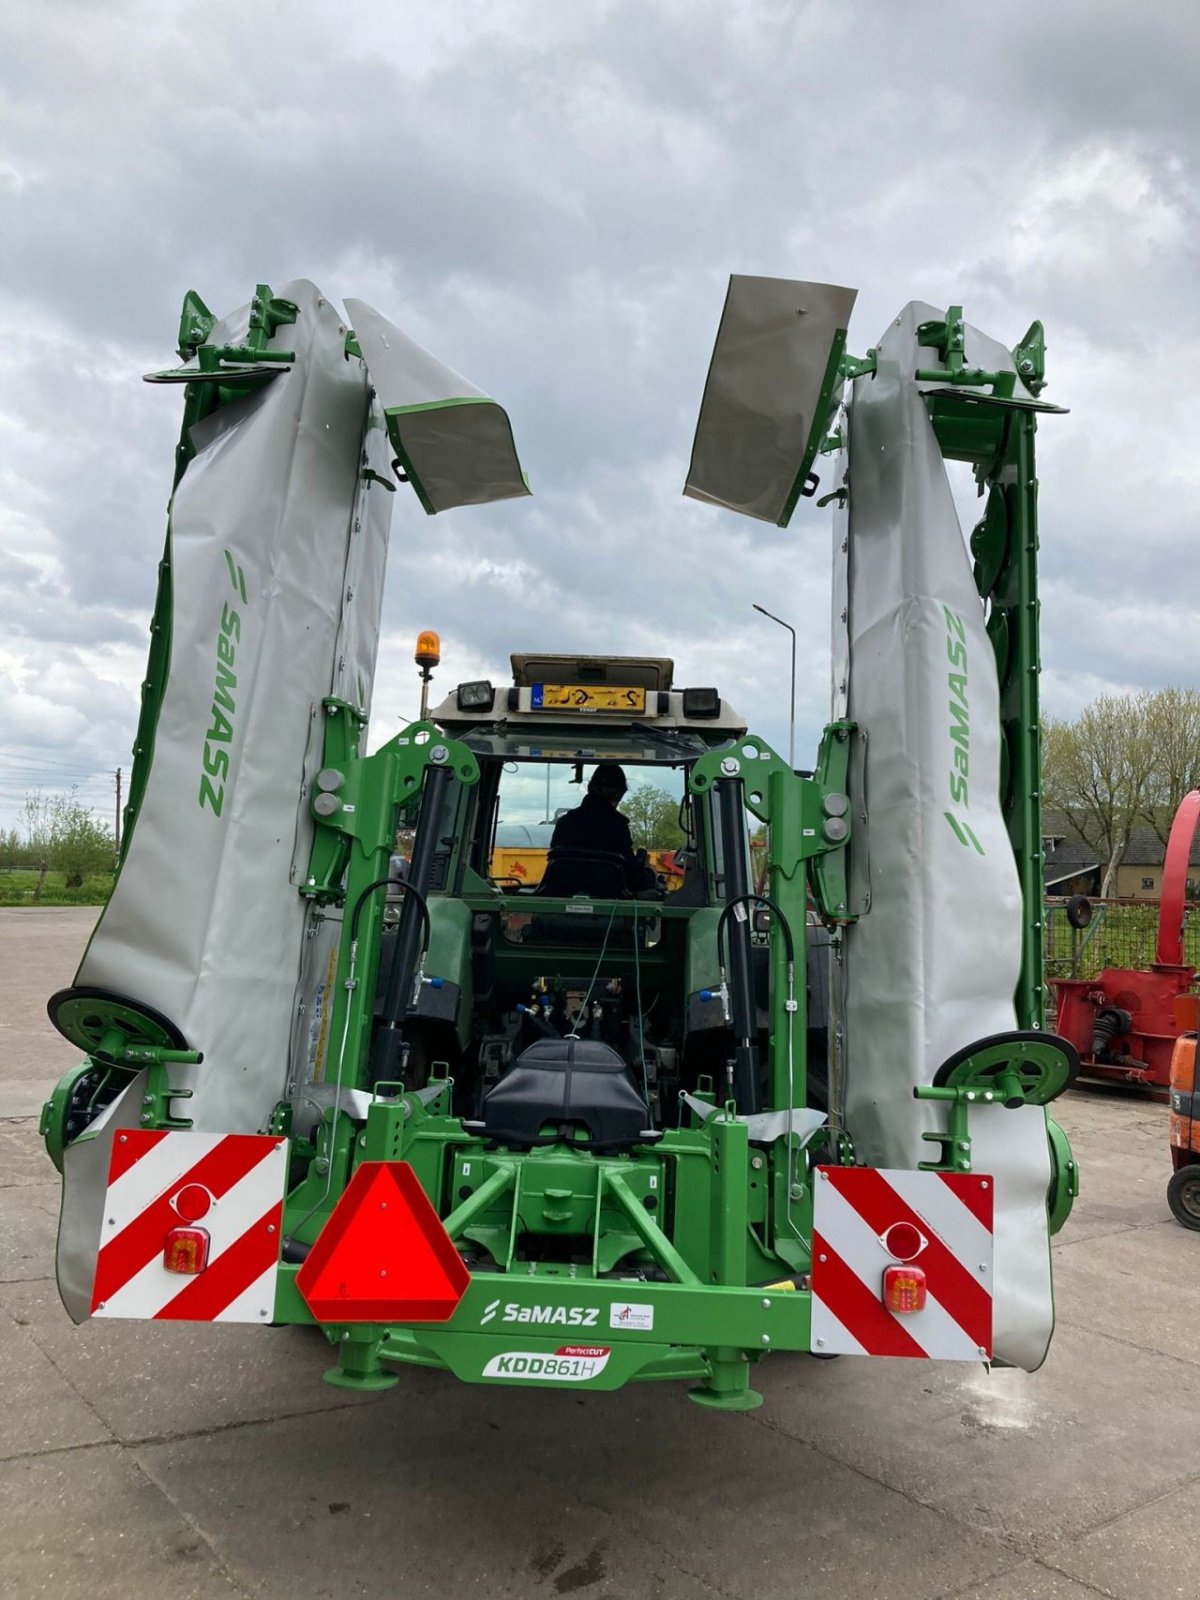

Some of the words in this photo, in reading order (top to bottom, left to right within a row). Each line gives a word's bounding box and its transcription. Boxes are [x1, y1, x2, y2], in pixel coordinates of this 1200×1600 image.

[199, 600, 241, 818] SaMASZ
[943, 604, 970, 810] SaMASZ
[502, 1303, 600, 1327] SaMASZ
[565, 1346, 605, 1356] PerfectCUT
[497, 1356, 596, 1377] KDD861H
